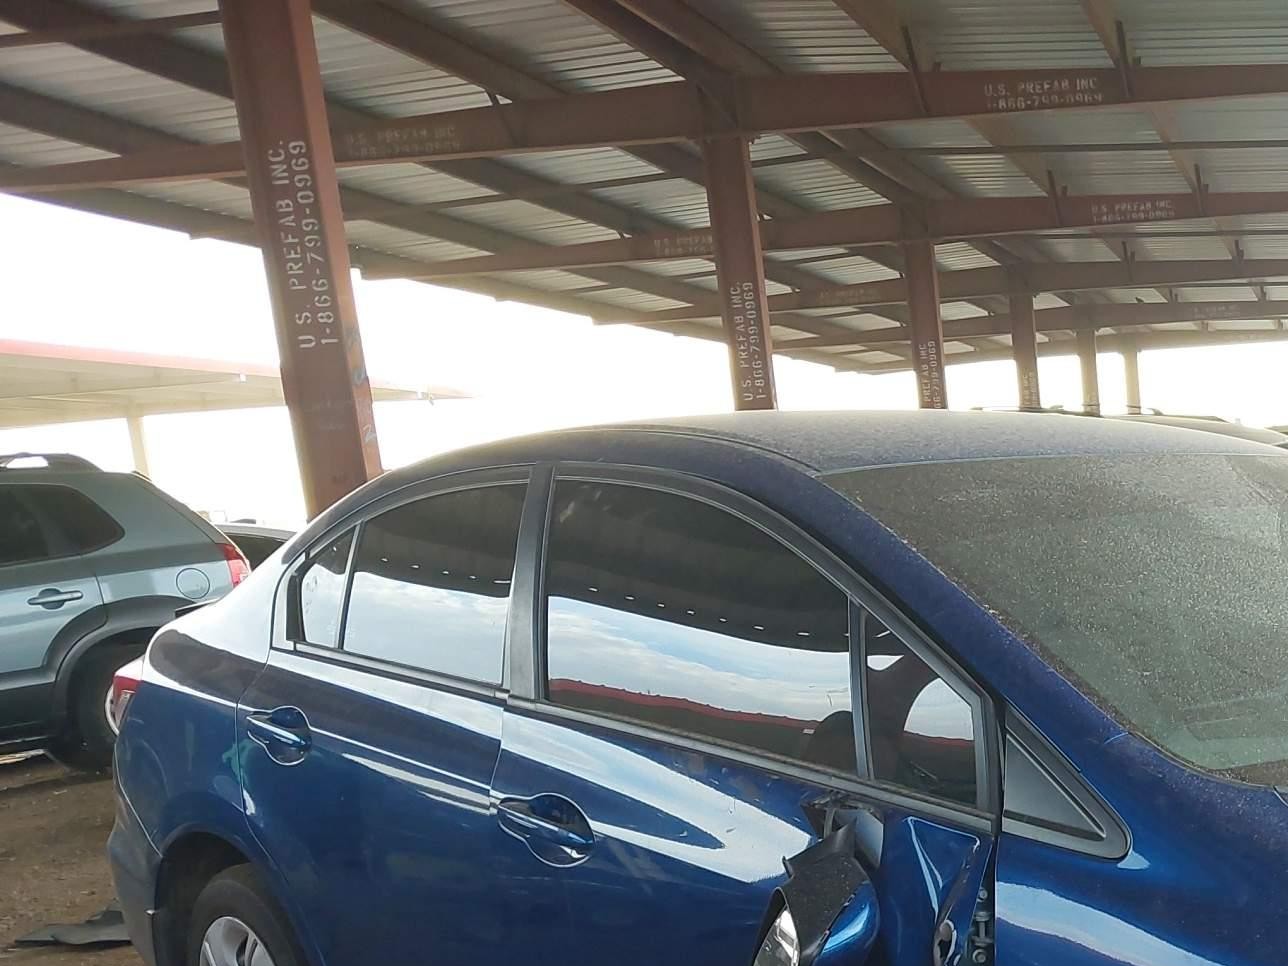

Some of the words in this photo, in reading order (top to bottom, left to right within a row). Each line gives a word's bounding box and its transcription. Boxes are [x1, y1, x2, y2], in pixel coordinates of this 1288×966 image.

[1017, 78, 1070, 94] PREFAB
[268, 140, 290, 186] INC.
[276, 199, 308, 291] PREFAB
[289, 140, 339, 345] 1-866-799-0969
[734, 315, 750, 368] PREFAB
[742, 282, 767, 399] 1-866-799-0969
